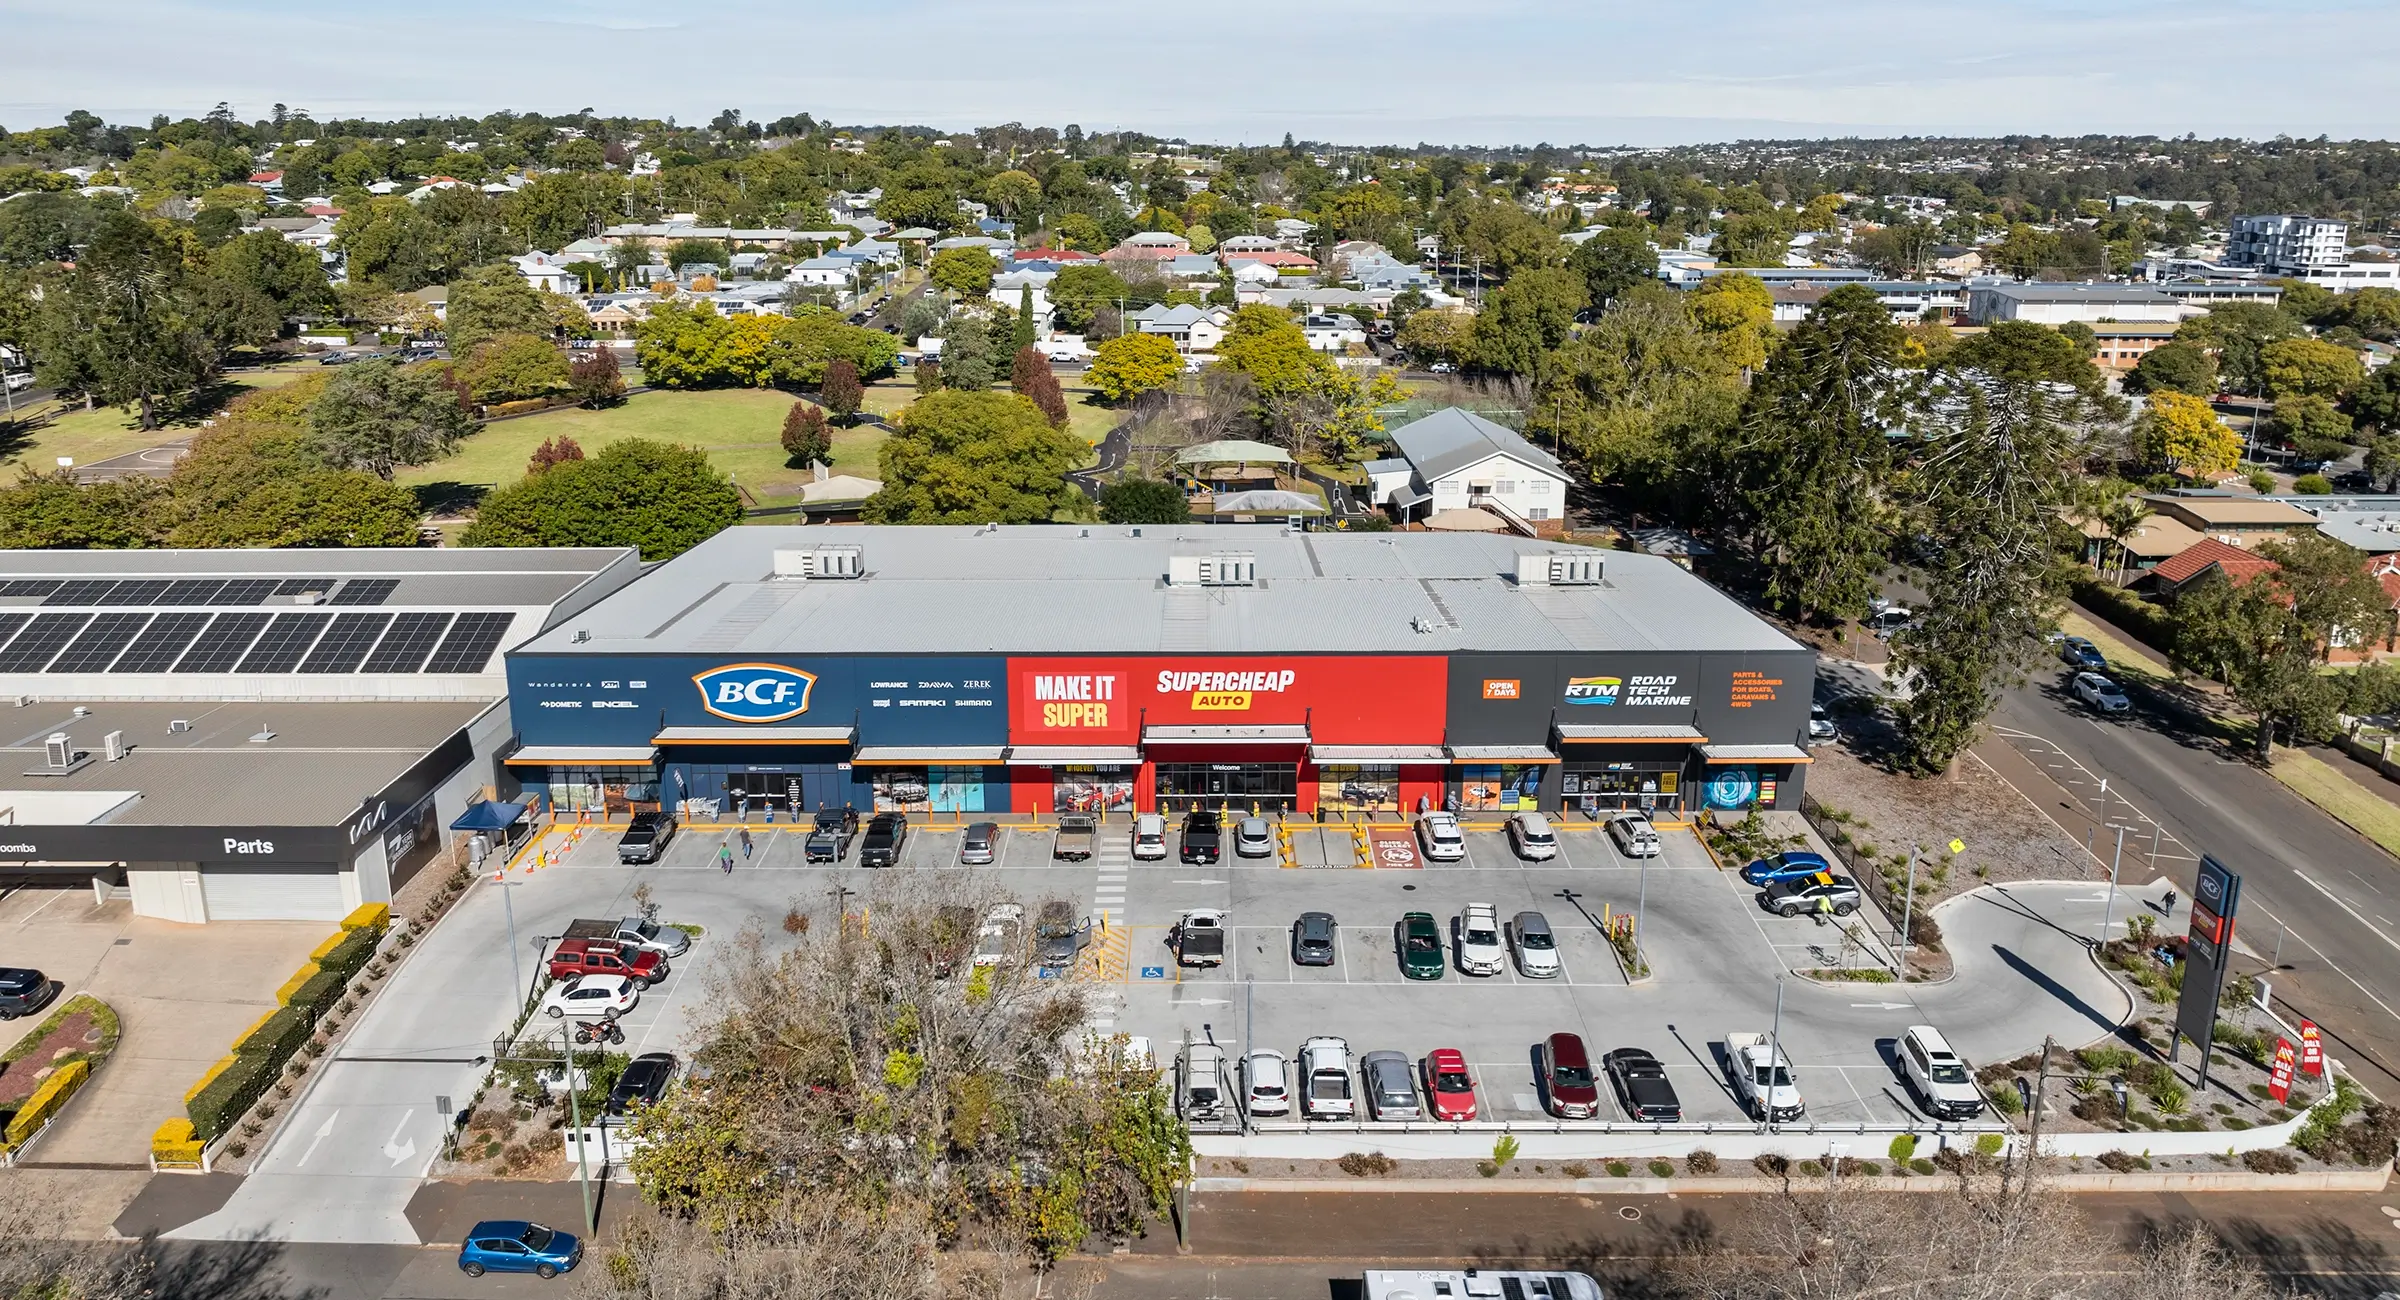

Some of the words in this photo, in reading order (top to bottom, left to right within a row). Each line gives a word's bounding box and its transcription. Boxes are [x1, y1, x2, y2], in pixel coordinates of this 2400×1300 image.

[963, 680, 991, 688] ZEREK
[1156, 670, 1295, 692] SUPERCHEAP
[1630, 675, 1677, 685] ROAD
[715, 678, 796, 705] BCF
[1035, 675, 1091, 700] MAKE
[1096, 675, 1115, 700] IT
[1489, 682, 1513, 690] OPEN
[1565, 685, 1620, 696] RTM
[1629, 686, 1670, 695] TECH
[1198, 696, 1245, 706] AUTO
[1626, 696, 1692, 706] MARINE
[1043, 703, 1108, 727] SUPER
[1096, 764, 1108, 772] YOU
[1109, 764, 1121, 772] ARE
[673, 768, 684, 788] YETI
[0, 842, 36, 853] oomba
[223, 838, 274, 854] Parts
[2202, 878, 2218, 894] BCF
[2275, 1060, 2293, 1072] SALE
[2276, 1070, 2288, 1080] ON
[2271, 1077, 2289, 1089] NOW
